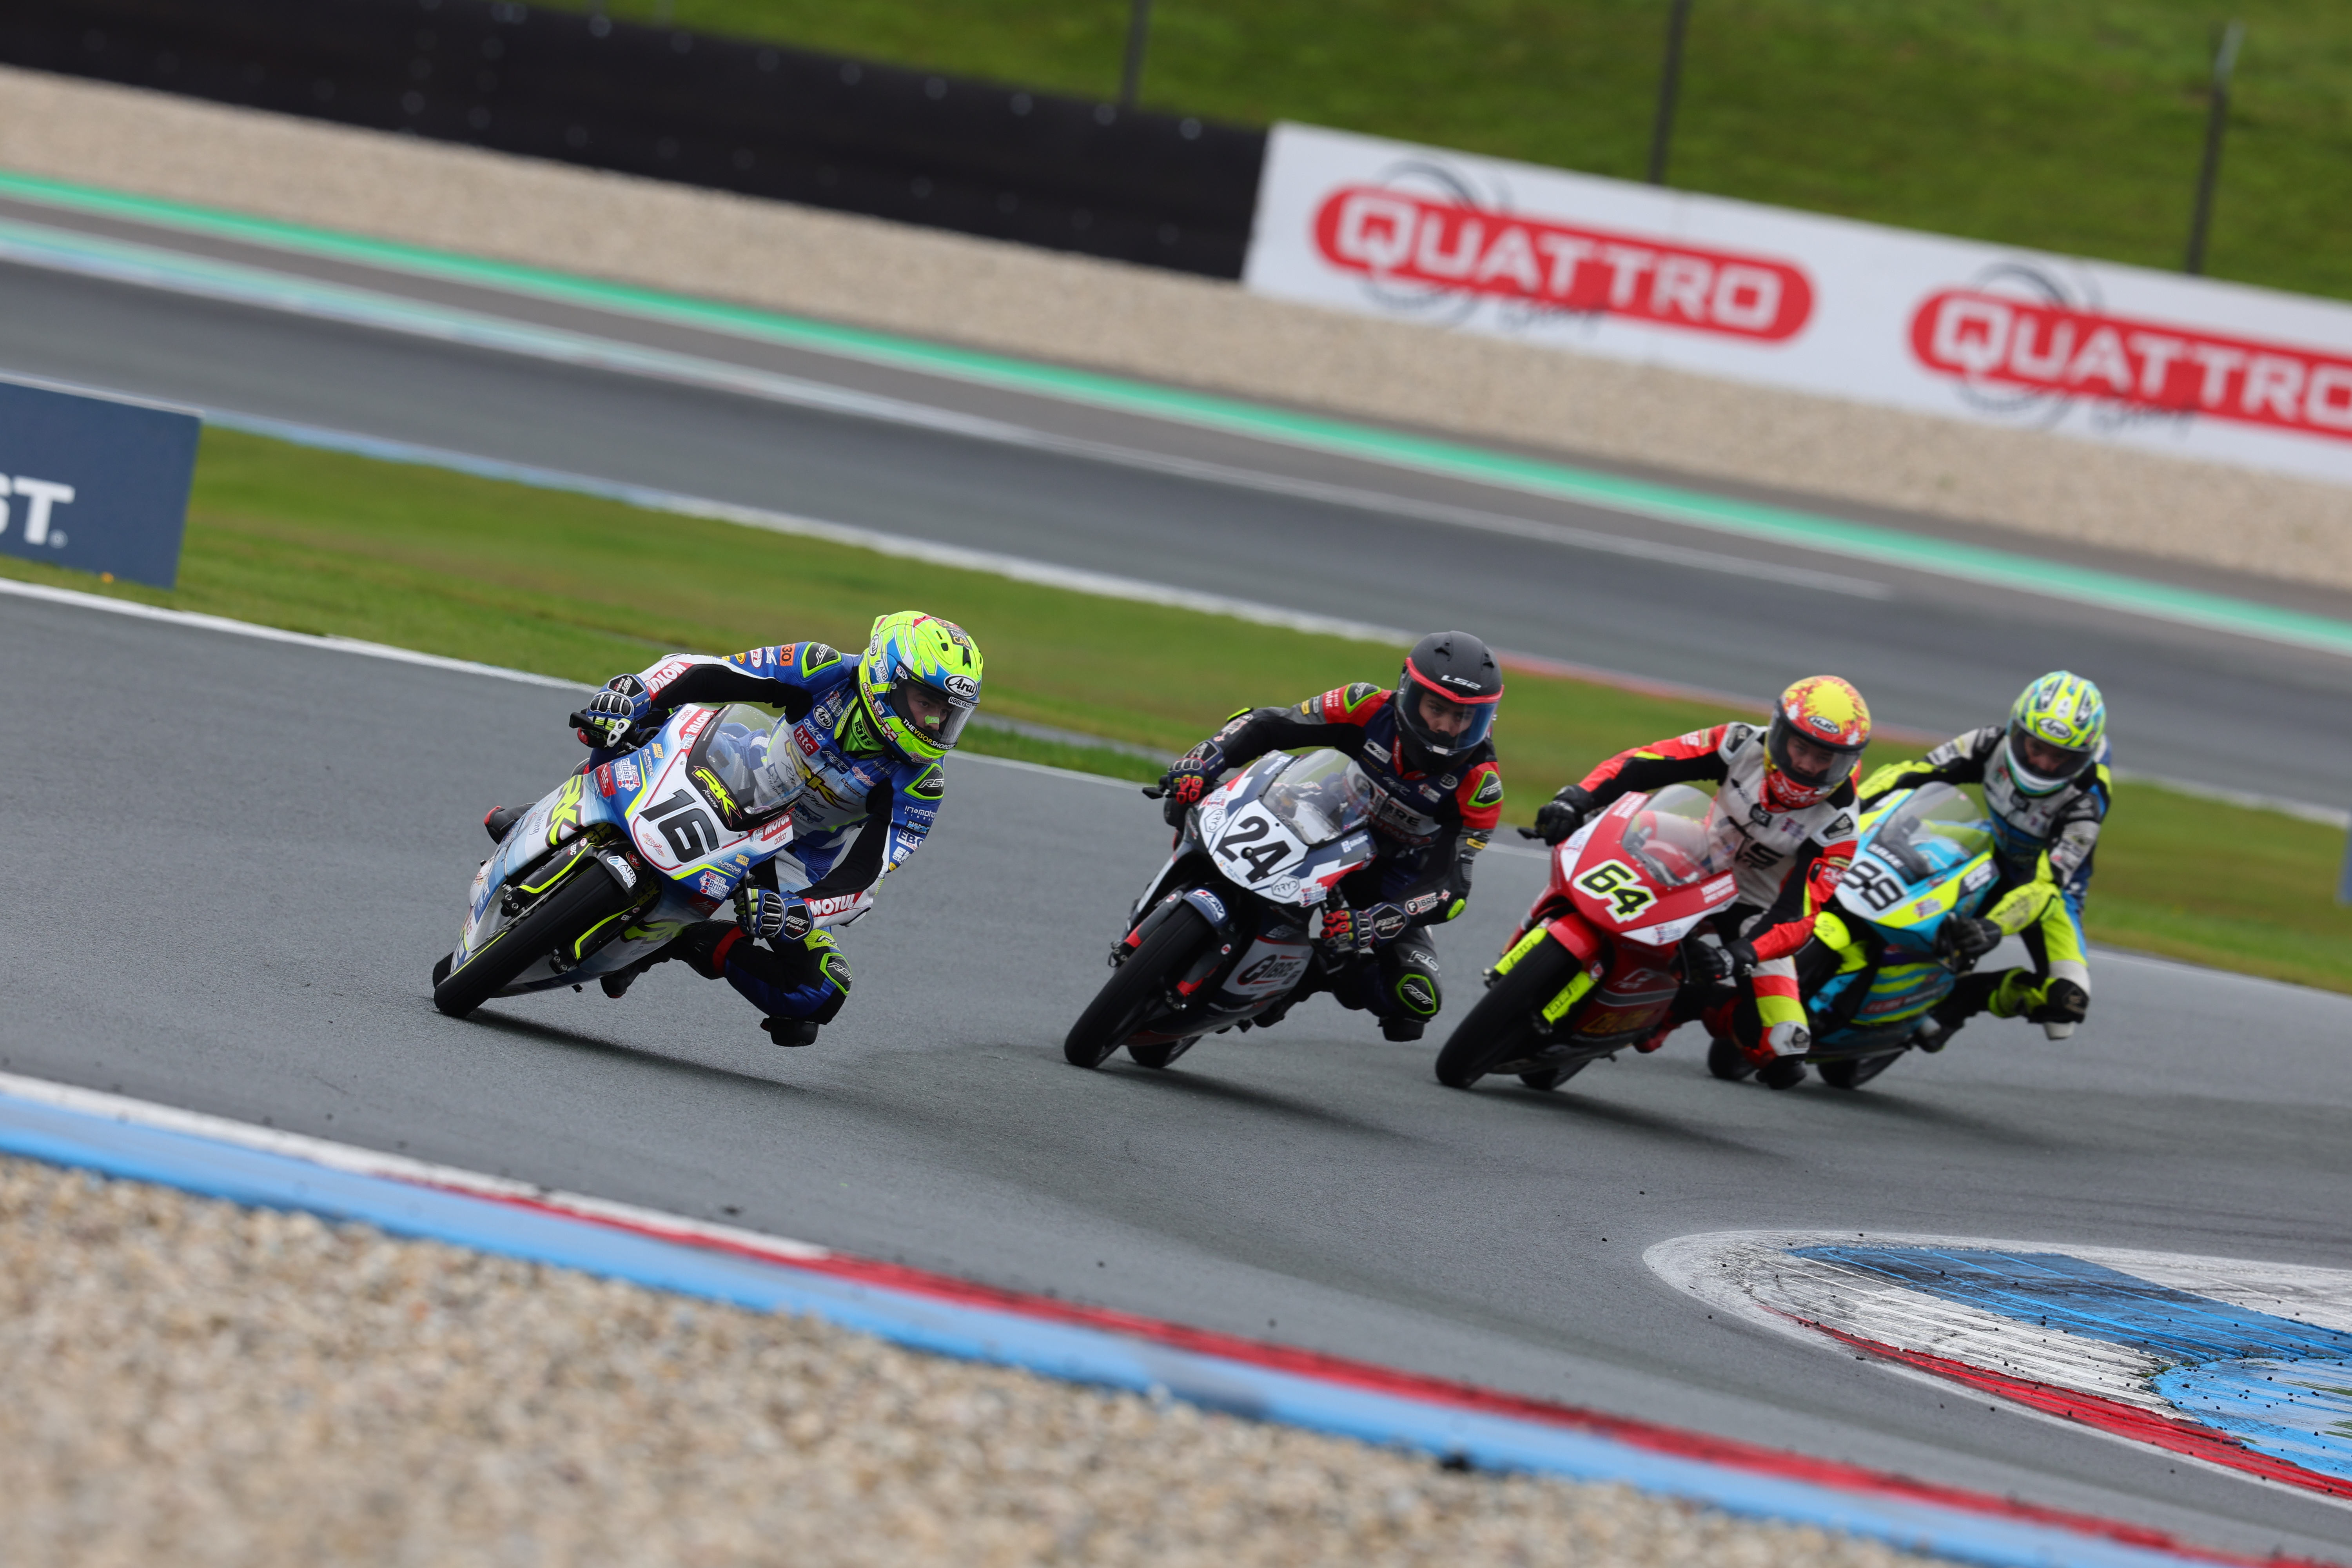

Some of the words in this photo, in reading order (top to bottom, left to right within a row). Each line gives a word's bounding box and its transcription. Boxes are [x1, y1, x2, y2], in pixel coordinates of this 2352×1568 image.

[1335, 192, 1784, 334] QUATTRO
[953, 637, 970, 647] CAB
[816, 644, 829, 666] RST
[645, 661, 686, 694] MOTUL
[879, 666, 887, 681] ARB
[1441, 675, 1482, 690] LS2
[622, 676, 633, 695] RST
[947, 677, 976, 694] Arai
[679, 710, 692, 721] aalco
[686, 711, 714, 733] MOTUL
[818, 709, 831, 726] Arai
[804, 718, 825, 740] aalco
[685, 740, 693, 749] ARB
[796, 727, 813, 752] htc
[622, 758, 632, 780] British
[644, 748, 654, 778] BURROWS
[822, 750, 849, 770] RST
[601, 764, 609, 789] htc
[917, 778, 944, 788] RST
[692, 766, 741, 826] RK
[702, 789, 718, 808] Racing
[639, 788, 720, 863] 16
[755, 828, 764, 836] ARB
[764, 815, 790, 836] MOTUL
[774, 832, 786, 845] aalco
[1216, 815, 1292, 884] 24
[622, 864, 636, 884] ARB
[717, 859, 742, 873] BURROWS
[618, 866, 632, 887] Biogas
[707, 887, 719, 897] Talent
[709, 881, 728, 894] British
[1581, 864, 1652, 916] 64
[809, 894, 855, 916] MOTUL
[786, 915, 809, 926] RST
